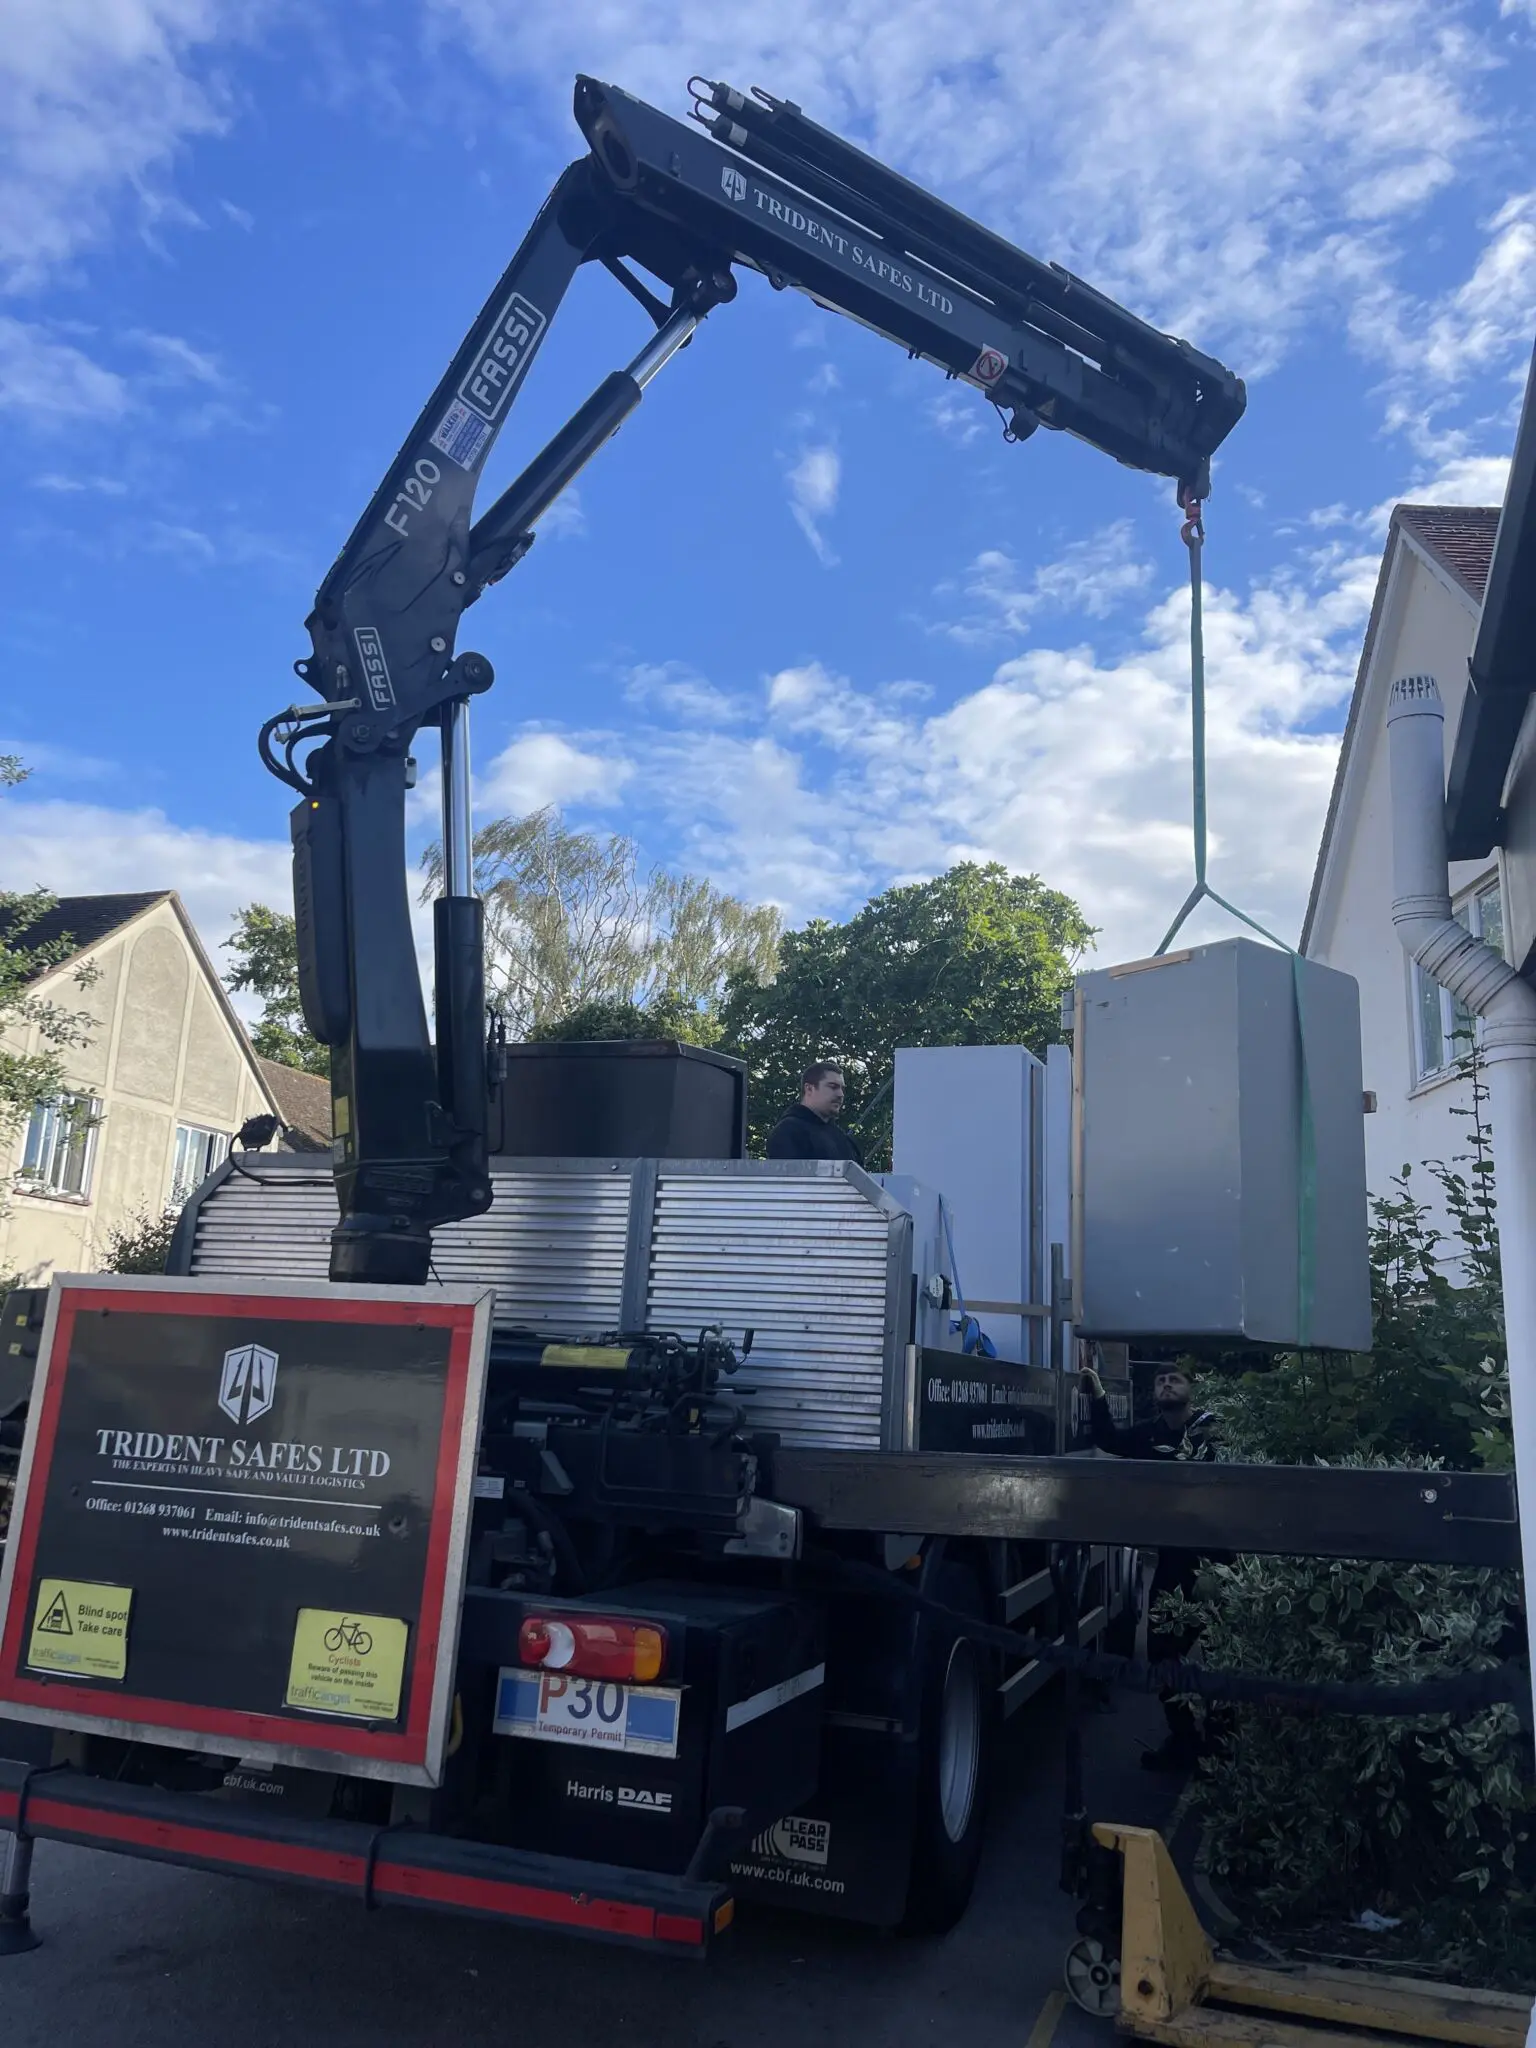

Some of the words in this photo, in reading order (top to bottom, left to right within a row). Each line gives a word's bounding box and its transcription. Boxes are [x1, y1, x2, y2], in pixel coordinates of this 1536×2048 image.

[754, 188, 848, 256] TRIDENT
[852, 246, 912, 293] SAFES
[918, 283, 953, 315] LTD
[471, 307, 536, 406] FASSI
[384, 459, 441, 537] F120
[360, 634, 390, 703] FASSI
[928, 1377, 950, 1402] Office:
[951, 1380, 969, 1403] 01268
[96, 1429, 224, 1464] TRIDENT
[229, 1439, 322, 1472] SAFES
[330, 1447, 391, 1477] LTD
[112, 1459, 131, 1469] THE
[133, 1460, 176, 1473] EXPERTS
[178, 1464, 188, 1474] IN
[191, 1465, 224, 1477] HEAVY
[226, 1468, 250, 1478] SAFE
[252, 1471, 274, 1481] AND
[276, 1473, 307, 1484] VAULT
[310, 1475, 366, 1489] LOGISTICS
[86, 1497, 121, 1512] Office:
[124, 1501, 156, 1515] 01268
[158, 1504, 195, 1519] 937061
[205, 1508, 243, 1523] Email:
[245, 1511, 381, 1537] info@tridentsafes.co.uk
[163, 1526, 290, 1549] www.tridentsafes.co.uk
[78, 1604, 104, 1617] Blind
[105, 1610, 128, 1622] spot
[78, 1620, 99, 1633] Take
[102, 1626, 122, 1636] care
[308, 1663, 331, 1673] Beware
[340, 1667, 364, 1678] passing
[366, 1671, 378, 1679] this
[328, 1654, 361, 1667] Cyclists
[311, 1674, 332, 1683] vehicle
[343, 1677, 353, 1685] the
[355, 1679, 374, 1688] inside
[538, 1720, 588, 1738] Temporary
[591, 1727, 622, 1742] Permit
[567, 1780, 613, 1802] Harris
[618, 1787, 672, 1808] DAF
[781, 1818, 827, 1838] CLEAR
[789, 1833, 825, 1852] PASS
[730, 1862, 845, 1894] www.cbf.uk.com
